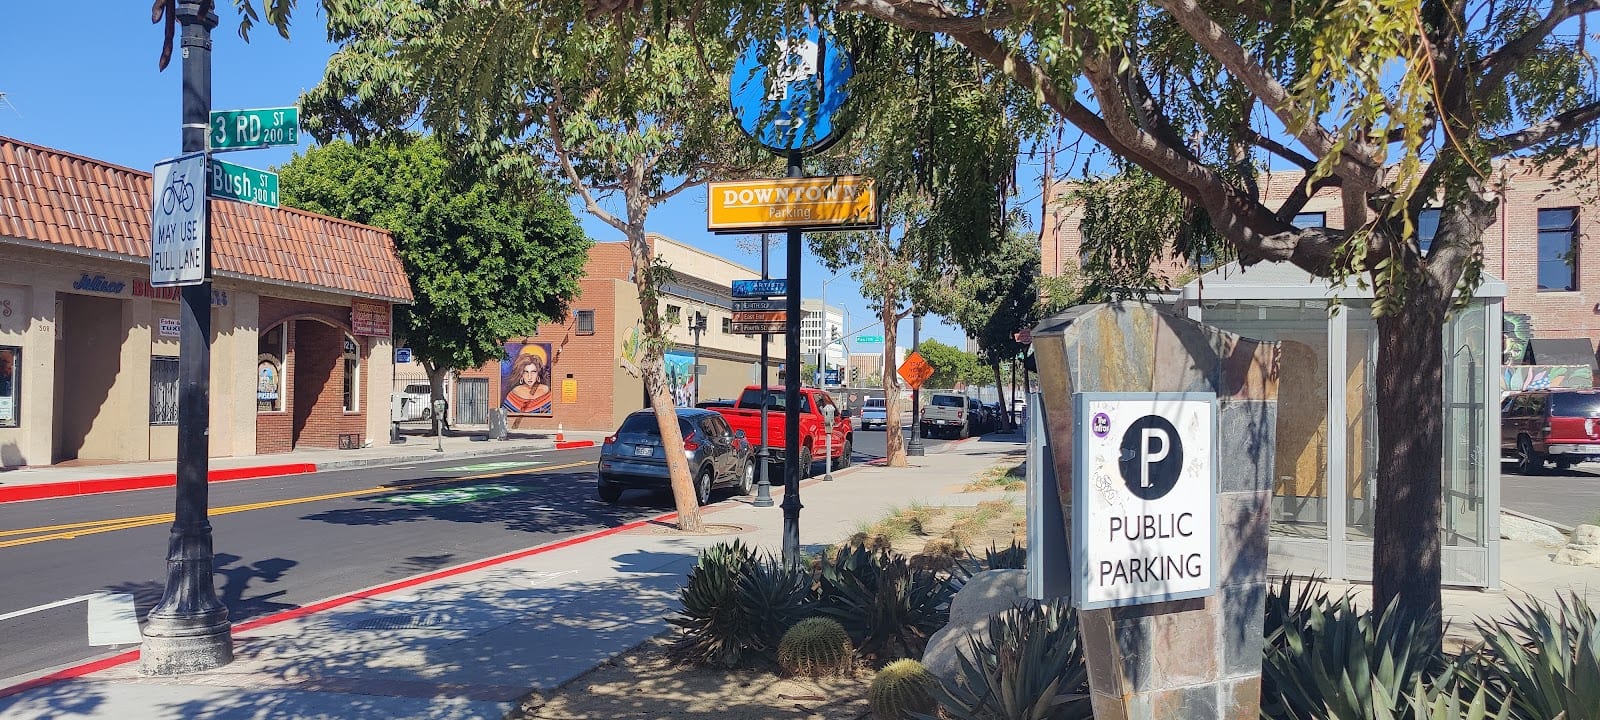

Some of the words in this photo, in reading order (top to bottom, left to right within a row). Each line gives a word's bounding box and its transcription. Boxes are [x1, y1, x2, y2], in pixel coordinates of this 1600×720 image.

[215, 116, 227, 143] 3
[236, 114, 261, 142] RD
[273, 112, 284, 126] ST
[263, 128, 283, 142] 200
[288, 127, 295, 142] E
[213, 164, 251, 198] Bush
[260, 174, 269, 188] ST
[252, 187, 268, 203] 300
[271, 191, 276, 204] N
[723, 184, 858, 205] DOWNTOWN
[769, 205, 811, 218] Parking
[158, 223, 177, 245] MAY
[180, 220, 198, 242] USE
[154, 251, 175, 272] FULL
[178, 247, 200, 269] LANE
[1140, 428, 1170, 488] P
[1109, 511, 1193, 543] PUBLIC
[1099, 552, 1202, 587] PARKING
